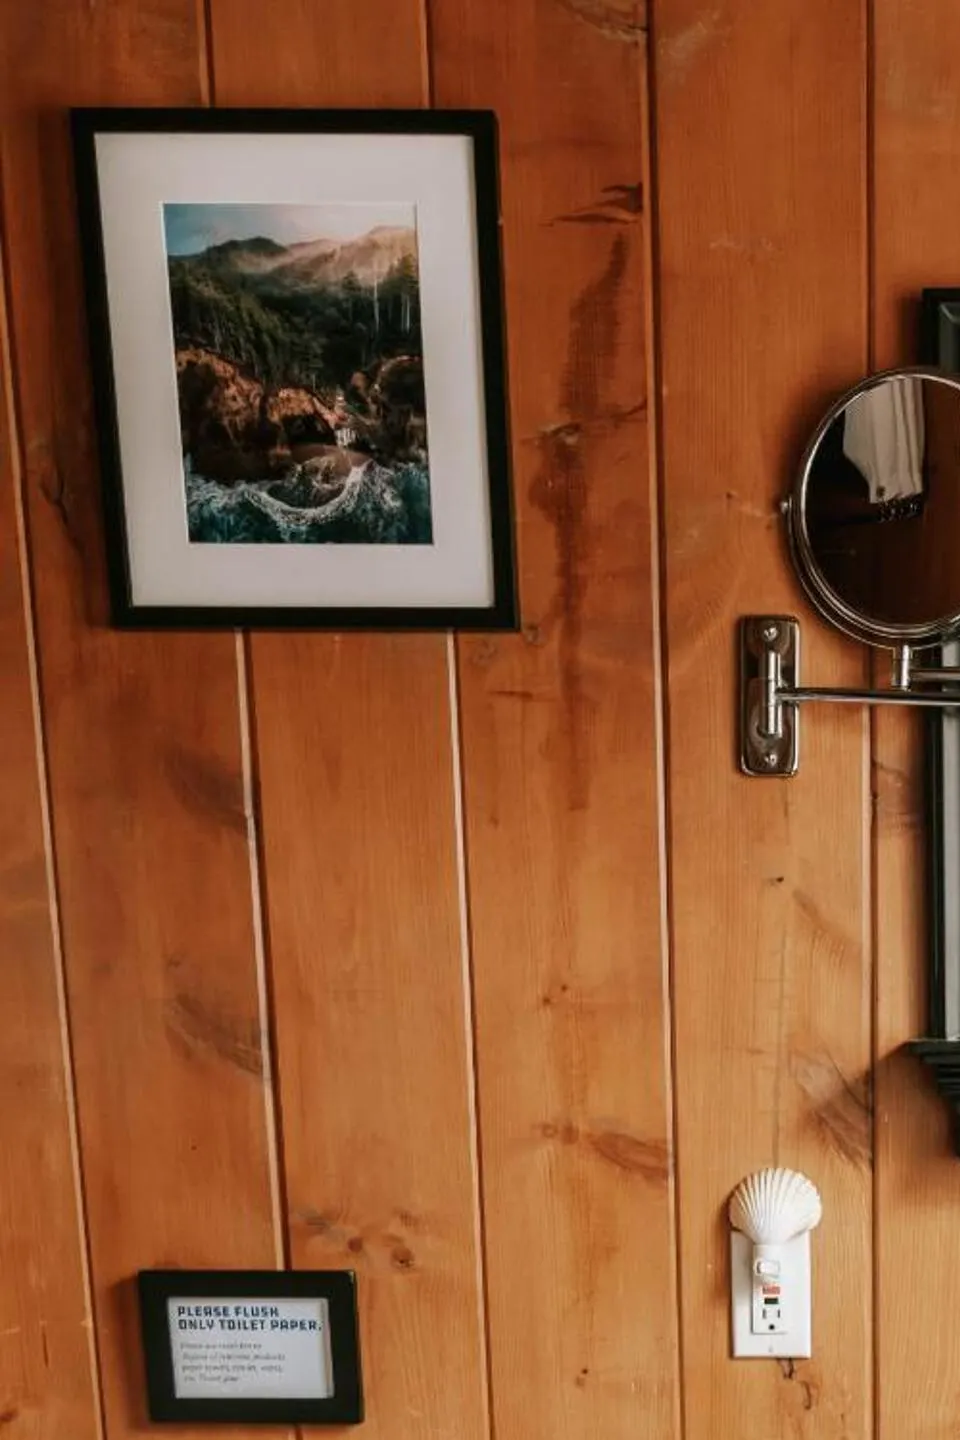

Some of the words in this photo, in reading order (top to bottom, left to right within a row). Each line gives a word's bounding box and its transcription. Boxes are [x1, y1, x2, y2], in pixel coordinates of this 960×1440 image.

[177, 1305, 231, 1317] PLEASE
[235, 1306, 280, 1317] FLUSH
[178, 1319, 215, 1330] ONLY
[219, 1319, 266, 1330] TOILET
[270, 1319, 323, 1331] PAPER.
